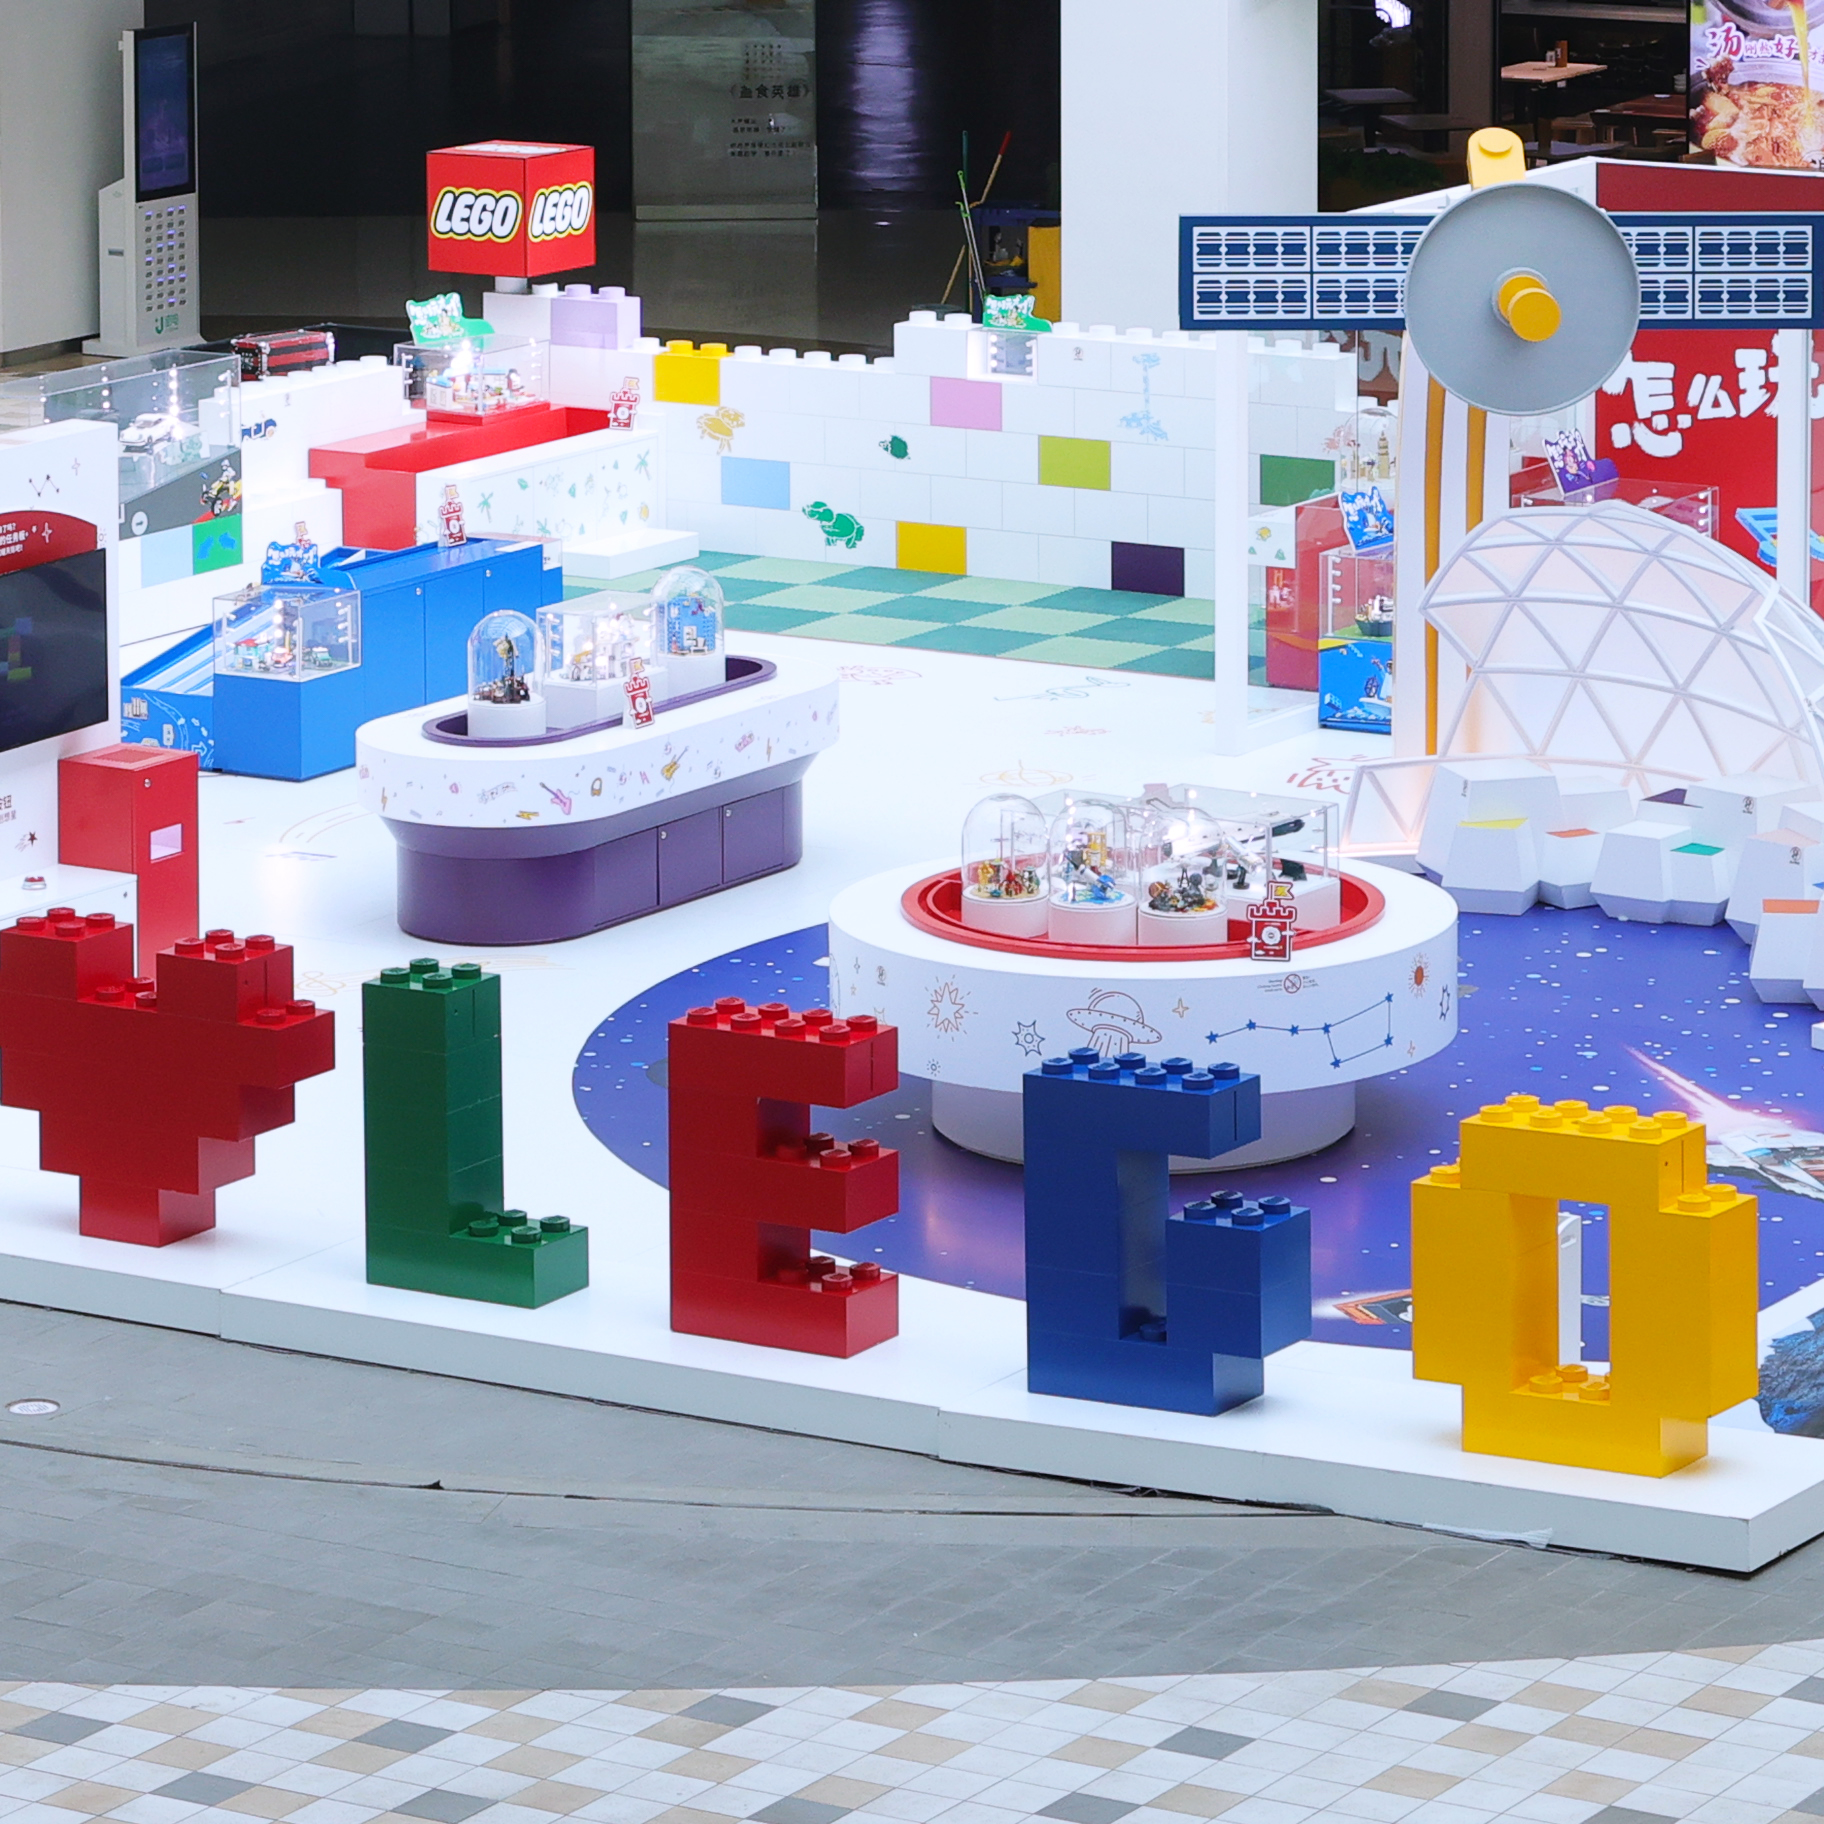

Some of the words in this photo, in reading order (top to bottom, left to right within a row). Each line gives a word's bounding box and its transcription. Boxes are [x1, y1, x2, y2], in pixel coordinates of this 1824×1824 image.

[433, 189, 521, 241] LEGO
[530, 184, 592, 238] LEGO
[361, 959, 1760, 1477] LEGO
